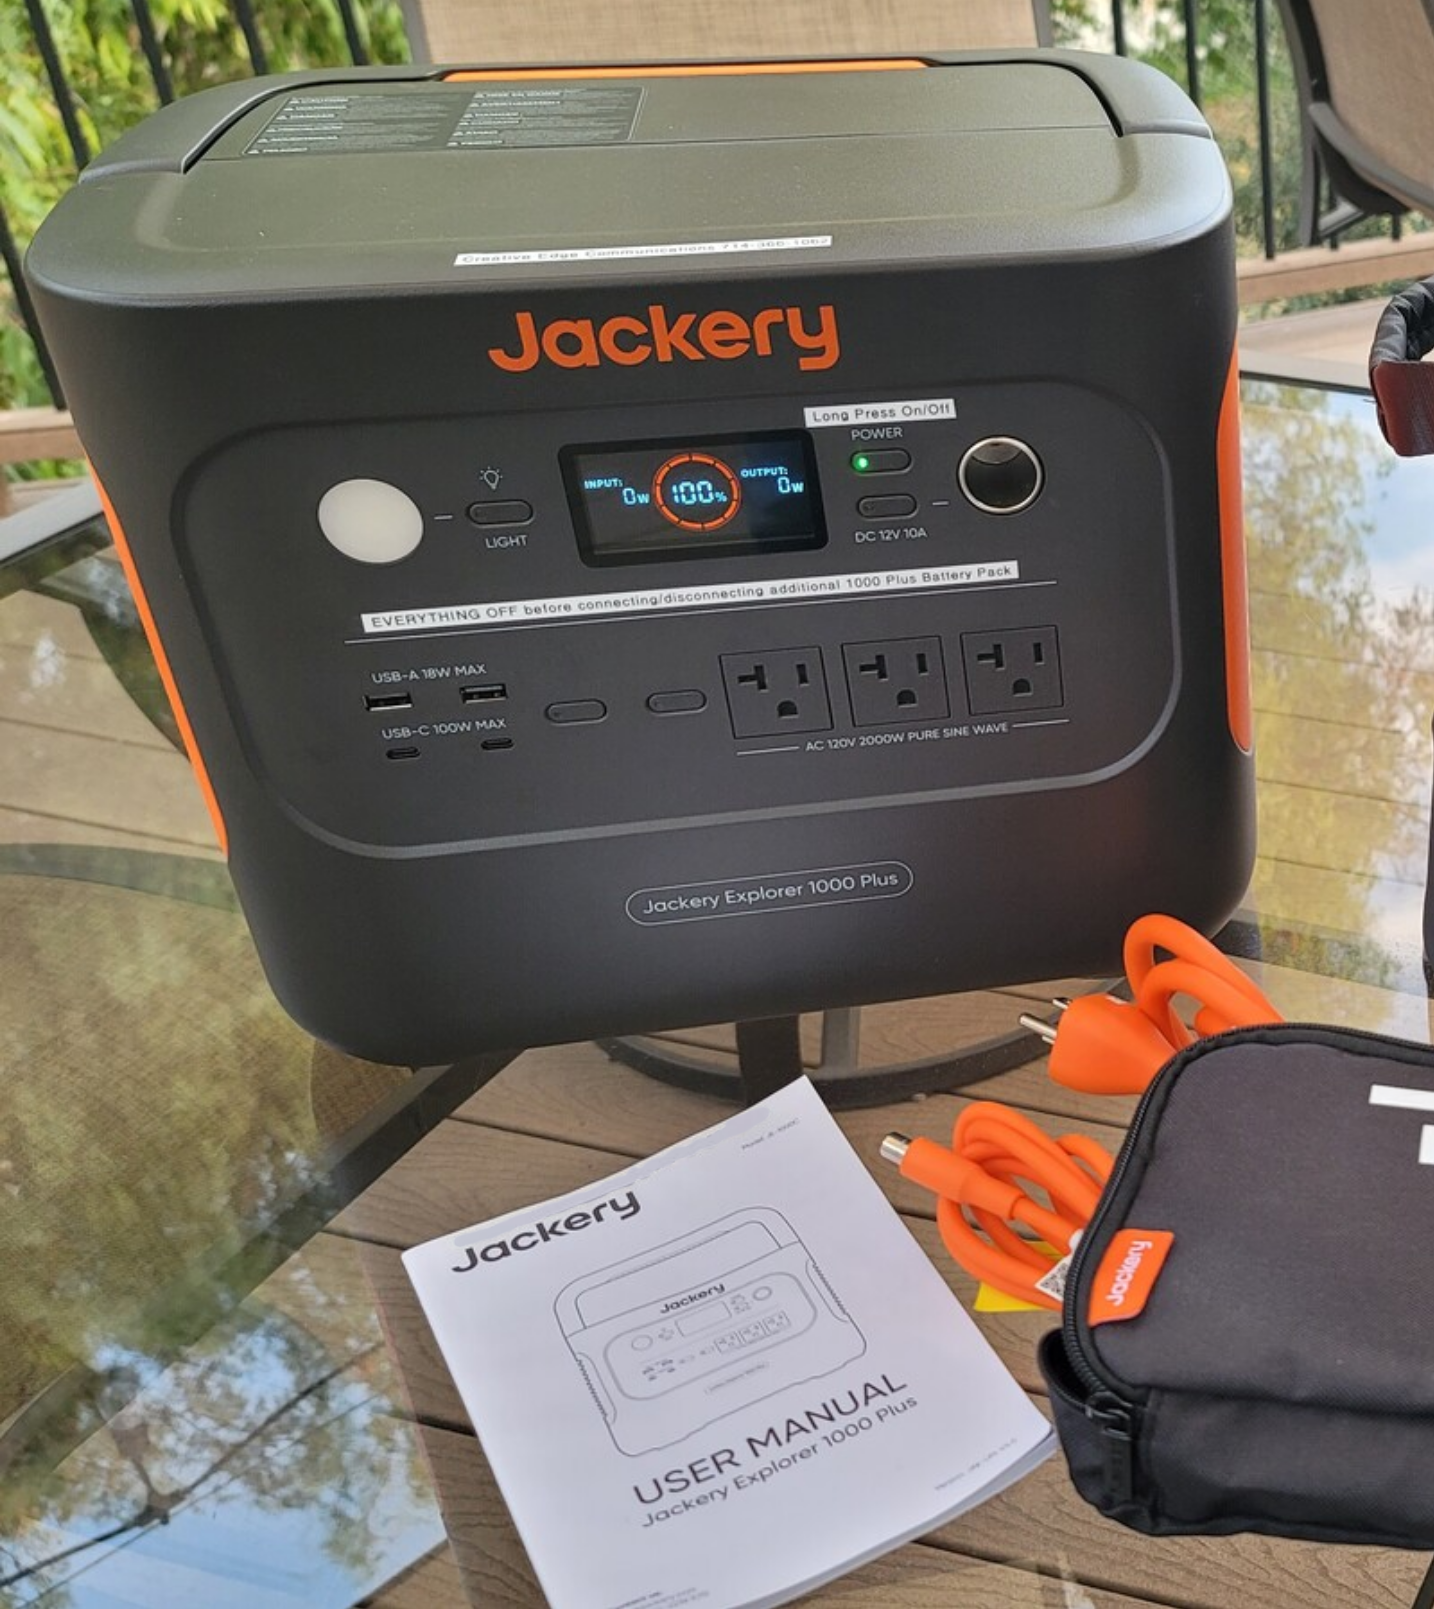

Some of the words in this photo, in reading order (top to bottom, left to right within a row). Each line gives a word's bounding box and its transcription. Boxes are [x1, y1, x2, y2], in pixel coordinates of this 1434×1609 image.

[488, 305, 840, 371] Jackery
[812, 410, 849, 422] Long
[854, 408, 896, 419] Press
[901, 404, 950, 417] On/Off
[851, 427, 903, 441] POWER
[583, 477, 623, 490] INPUT:
[740, 465, 789, 478] OUTPUT:
[671, 480, 728, 505] 100%
[485, 534, 528, 549] LIGHT
[854, 530, 877, 543] DC
[878, 528, 901, 540] 12V
[903, 527, 928, 539] 10A
[371, 608, 481, 628] EVERYTHING
[486, 604, 519, 618] OFF
[523, 600, 572, 615] before
[577, 585, 764, 611] connecting/disconnecting
[769, 579, 841, 596] additional
[845, 577, 880, 589] 1000
[886, 572, 917, 585] Plus
[922, 567, 972, 583] Battery
[977, 564, 1012, 578] Pack
[371, 669, 420, 684] USB-A
[421, 667, 451, 680] 18W
[454, 663, 487, 677] MAX
[381, 725, 430, 740] USB-C
[432, 721, 472, 735] 100W
[475, 717, 507, 731] MAX
[805, 740, 825, 751] AC
[826, 738, 856, 749] 120V
[859, 734, 905, 747] 2000W
[908, 730, 940, 742] PURE
[943, 725, 969, 737] SINE
[972, 722, 1009, 735] WAVE
[643, 892, 720, 915] Jackery
[724, 884, 804, 906] Explorer
[807, 876, 855, 895] 1000
[860, 871, 900, 889] Plus
[451, 1191, 641, 1273] Jackery
[1105, 1240, 1153, 1307] Jackery
[660, 1283, 725, 1314] Jackery
[633, 1448, 741, 1505] USER
[746, 1374, 907, 1458] MANUAL
[641, 1485, 729, 1528] Jackery
[733, 1442, 819, 1491] Explorer
[822, 1415, 873, 1448] 1000
[875, 1396, 918, 1423] Plus
